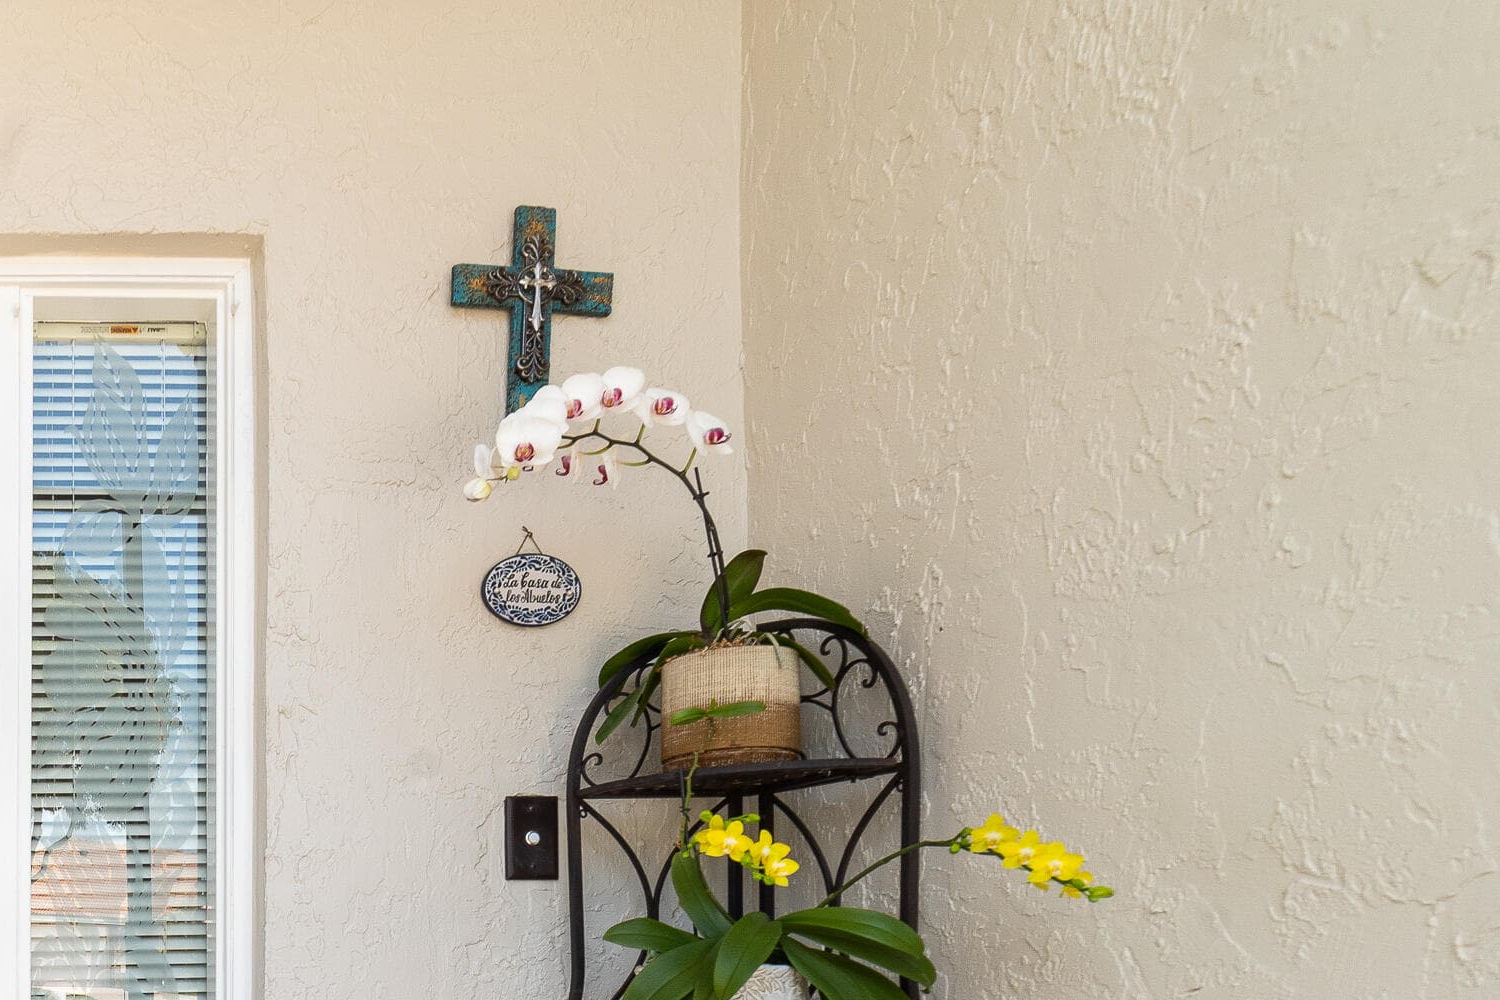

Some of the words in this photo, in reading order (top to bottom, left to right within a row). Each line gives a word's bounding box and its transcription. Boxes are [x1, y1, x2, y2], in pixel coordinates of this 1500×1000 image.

[503, 573, 519, 588] La
[551, 576, 563, 588] de
[521, 588, 561, 604] Abuelos
